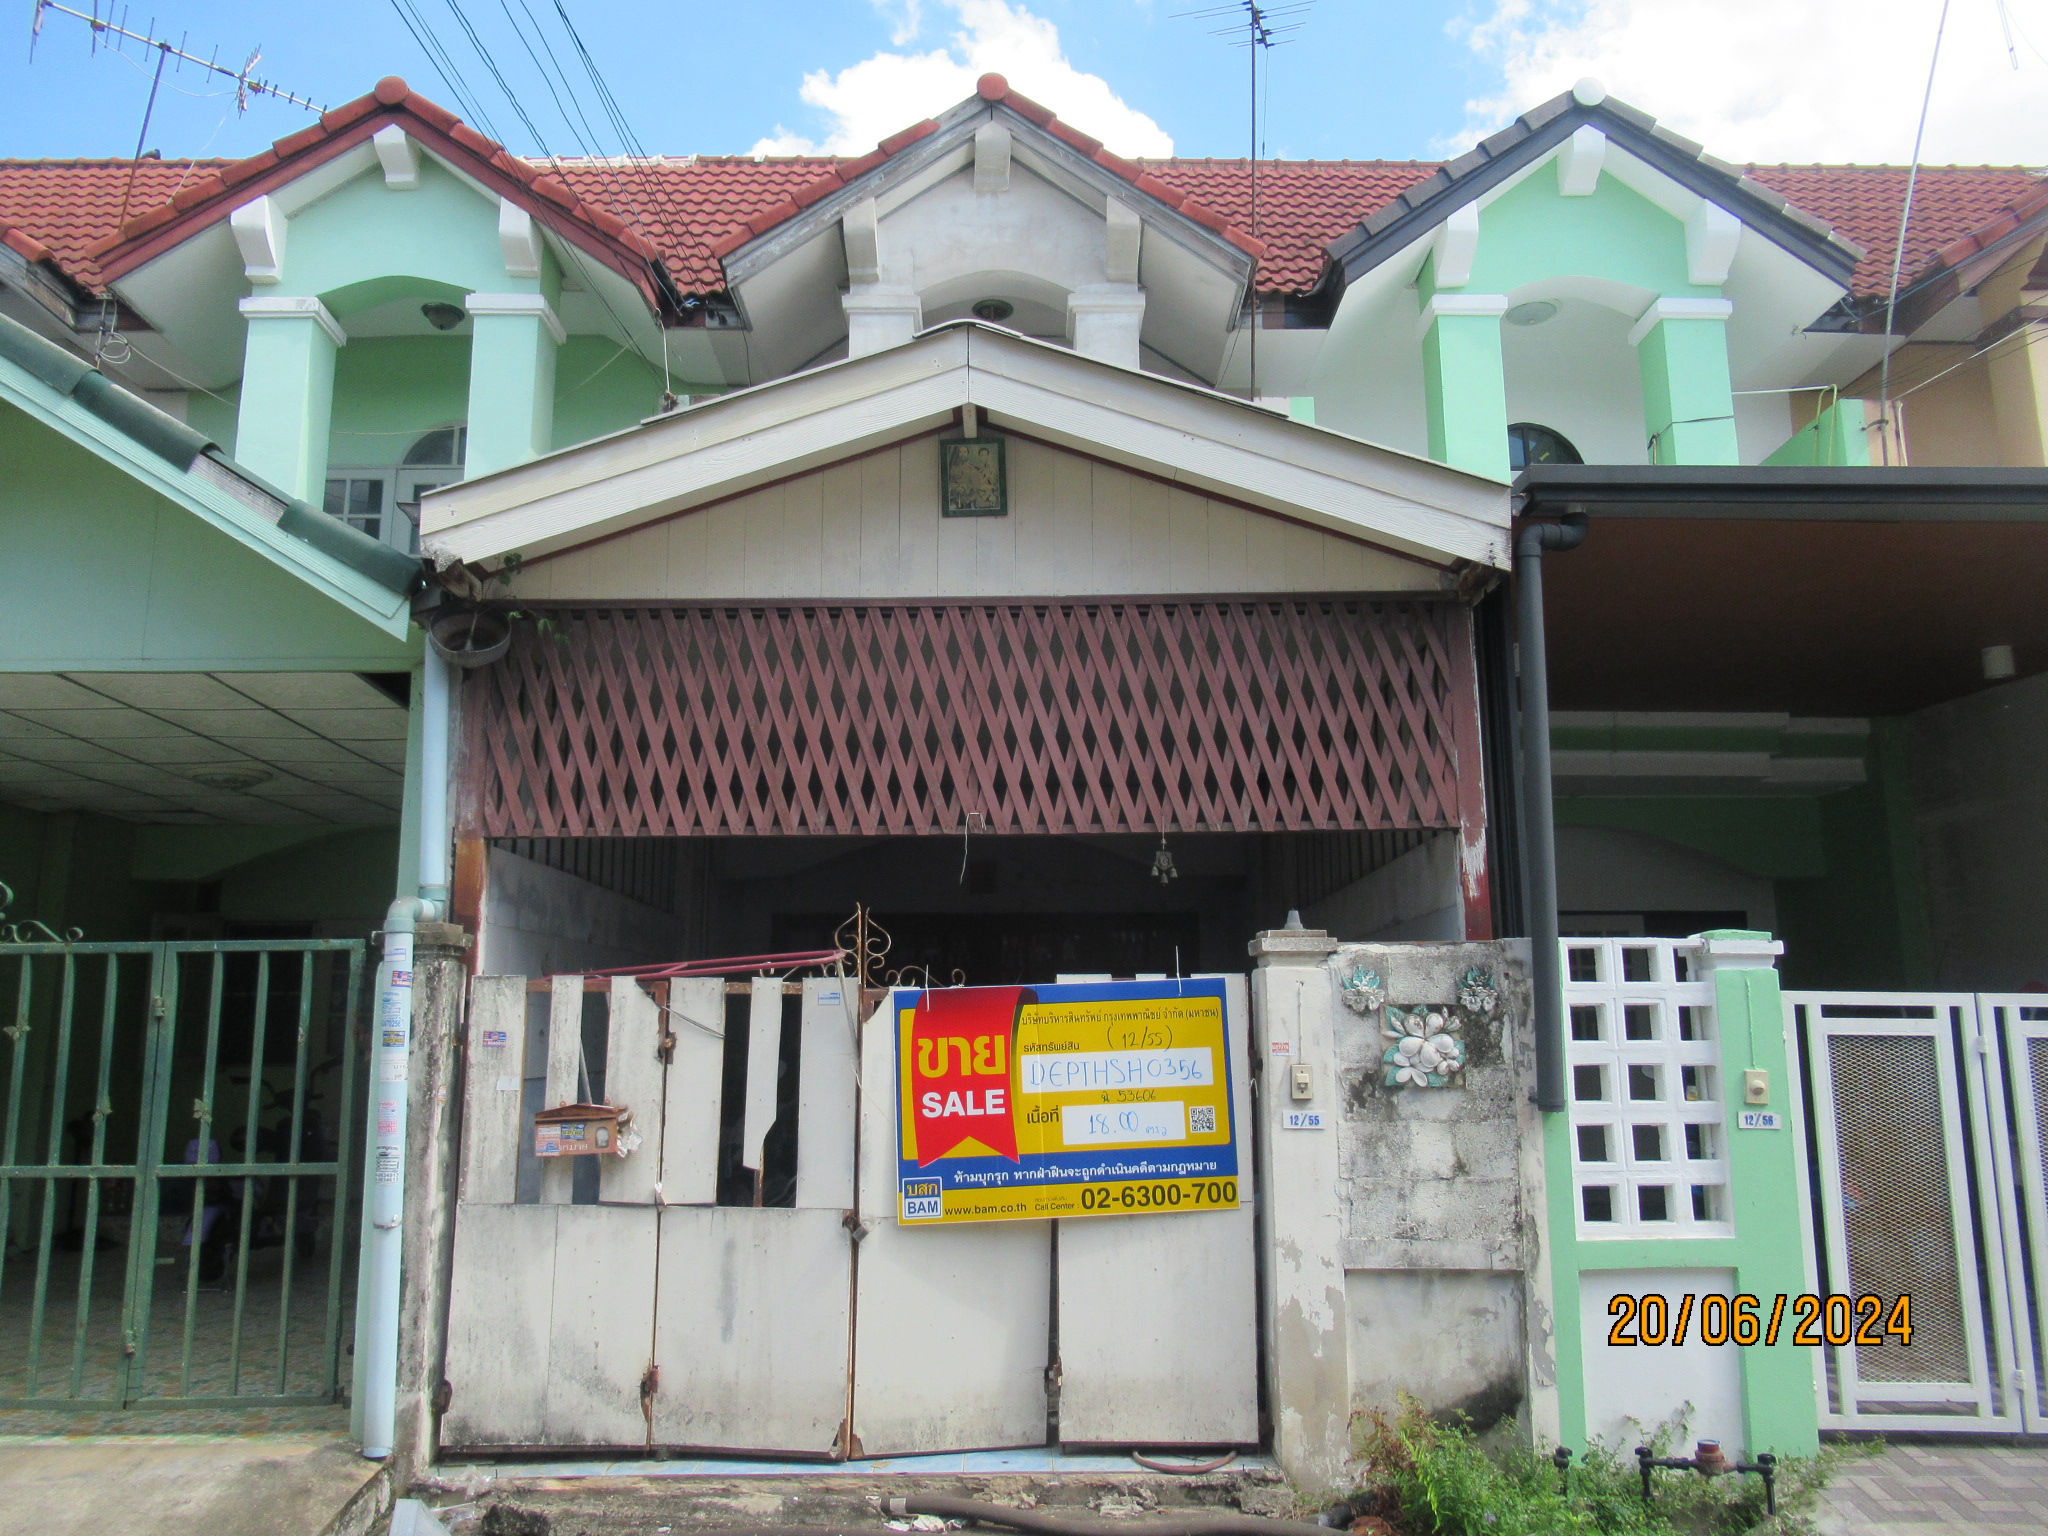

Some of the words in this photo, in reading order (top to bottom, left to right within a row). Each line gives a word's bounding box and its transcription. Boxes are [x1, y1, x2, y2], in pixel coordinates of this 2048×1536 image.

[1103, 1008, 1161, 1026] กรุงเทพพาณิชย์
[1162, 1008, 1183, 1020] จำกัด
[1185, 1008, 1219, 1021] (มหาชน)
[1023, 1041, 1080, 1053] รหัสทรัพย์สิน
[917, 1035, 1006, 1078] ขาย
[922, 1088, 1006, 1118] SALE
[1027, 1105, 1060, 1125] เนื้อที่
[1289, 1114, 1320, 1127] 12/55
[953, 1170, 1009, 1186] ห้ามบุกรุก
[1081, 1181, 1237, 1210] 02-6300-700
[907, 1200, 938, 1215] BAM
[945, 1203, 1027, 1216] www.bam.co.th
[1034, 1203, 1049, 1211] Call
